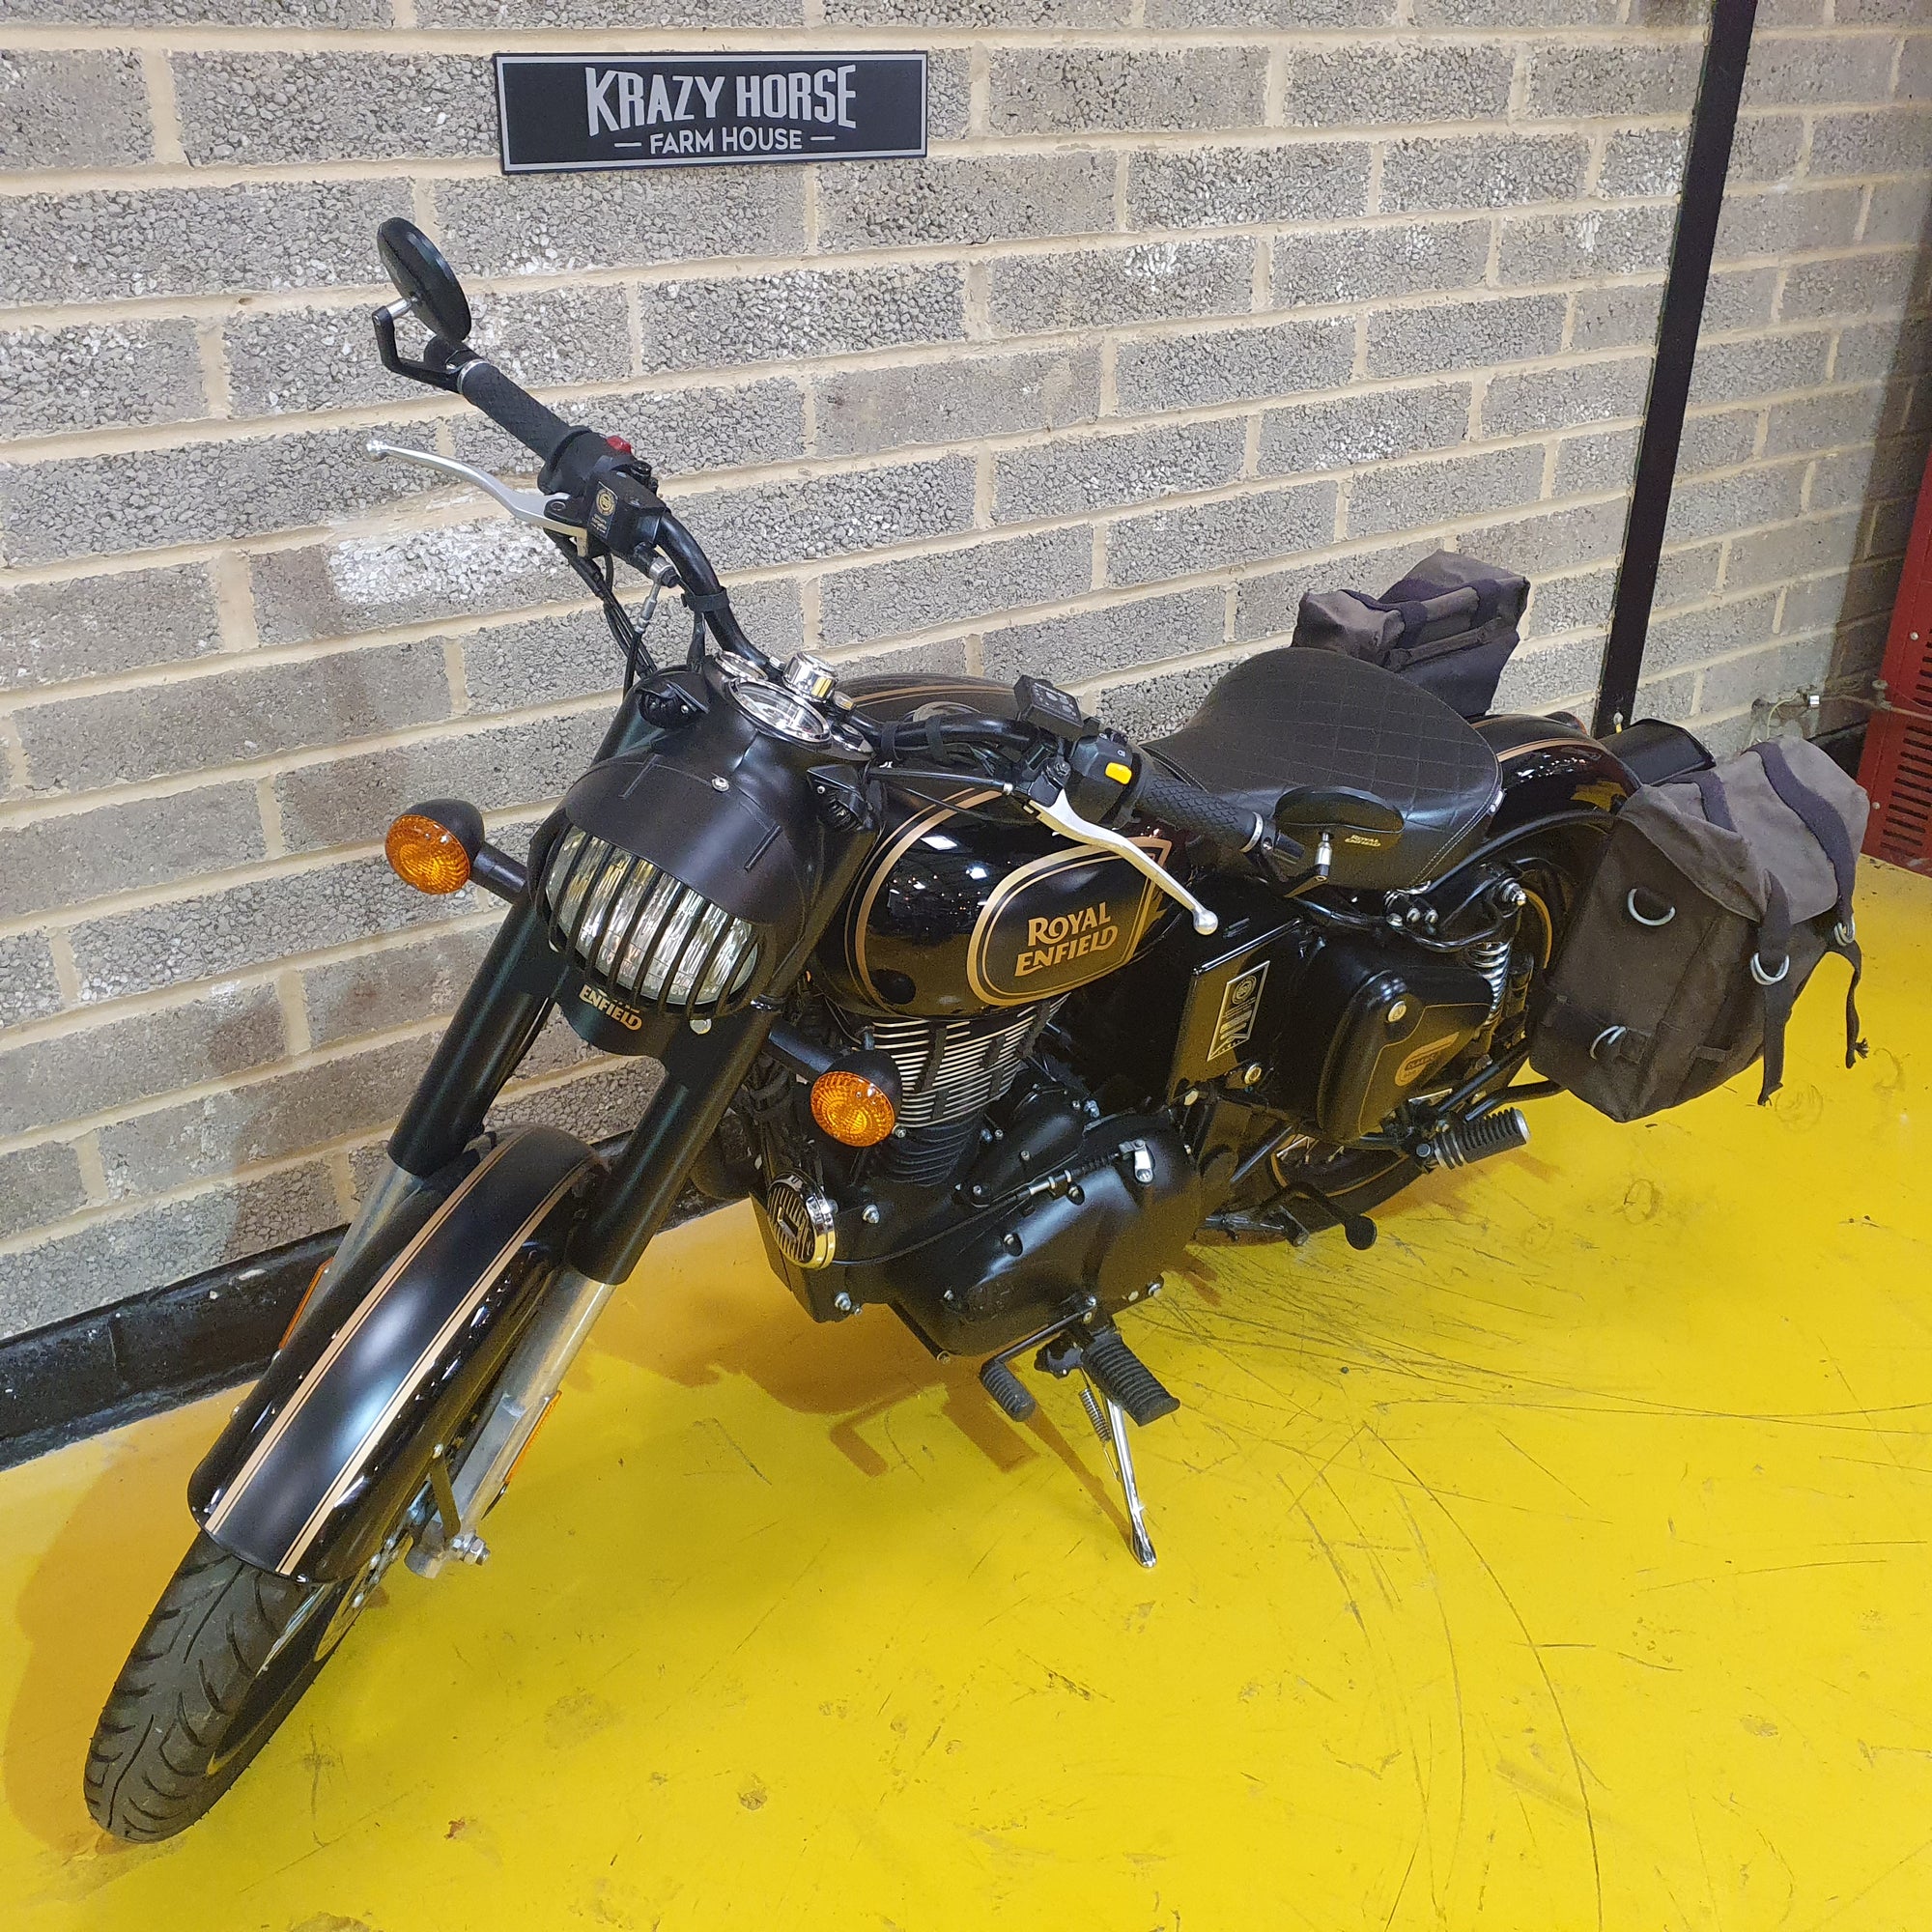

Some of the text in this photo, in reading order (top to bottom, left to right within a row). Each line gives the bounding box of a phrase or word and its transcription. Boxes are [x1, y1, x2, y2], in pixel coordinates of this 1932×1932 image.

[585, 64, 857, 137] KRAZY HORSE
[650, 126, 803, 155] FARM HOUSE
[1028, 901, 1111, 947] ROYAL
[1014, 925, 1119, 977] ENFIELD
[579, 983, 642, 1031] ENFIELD
